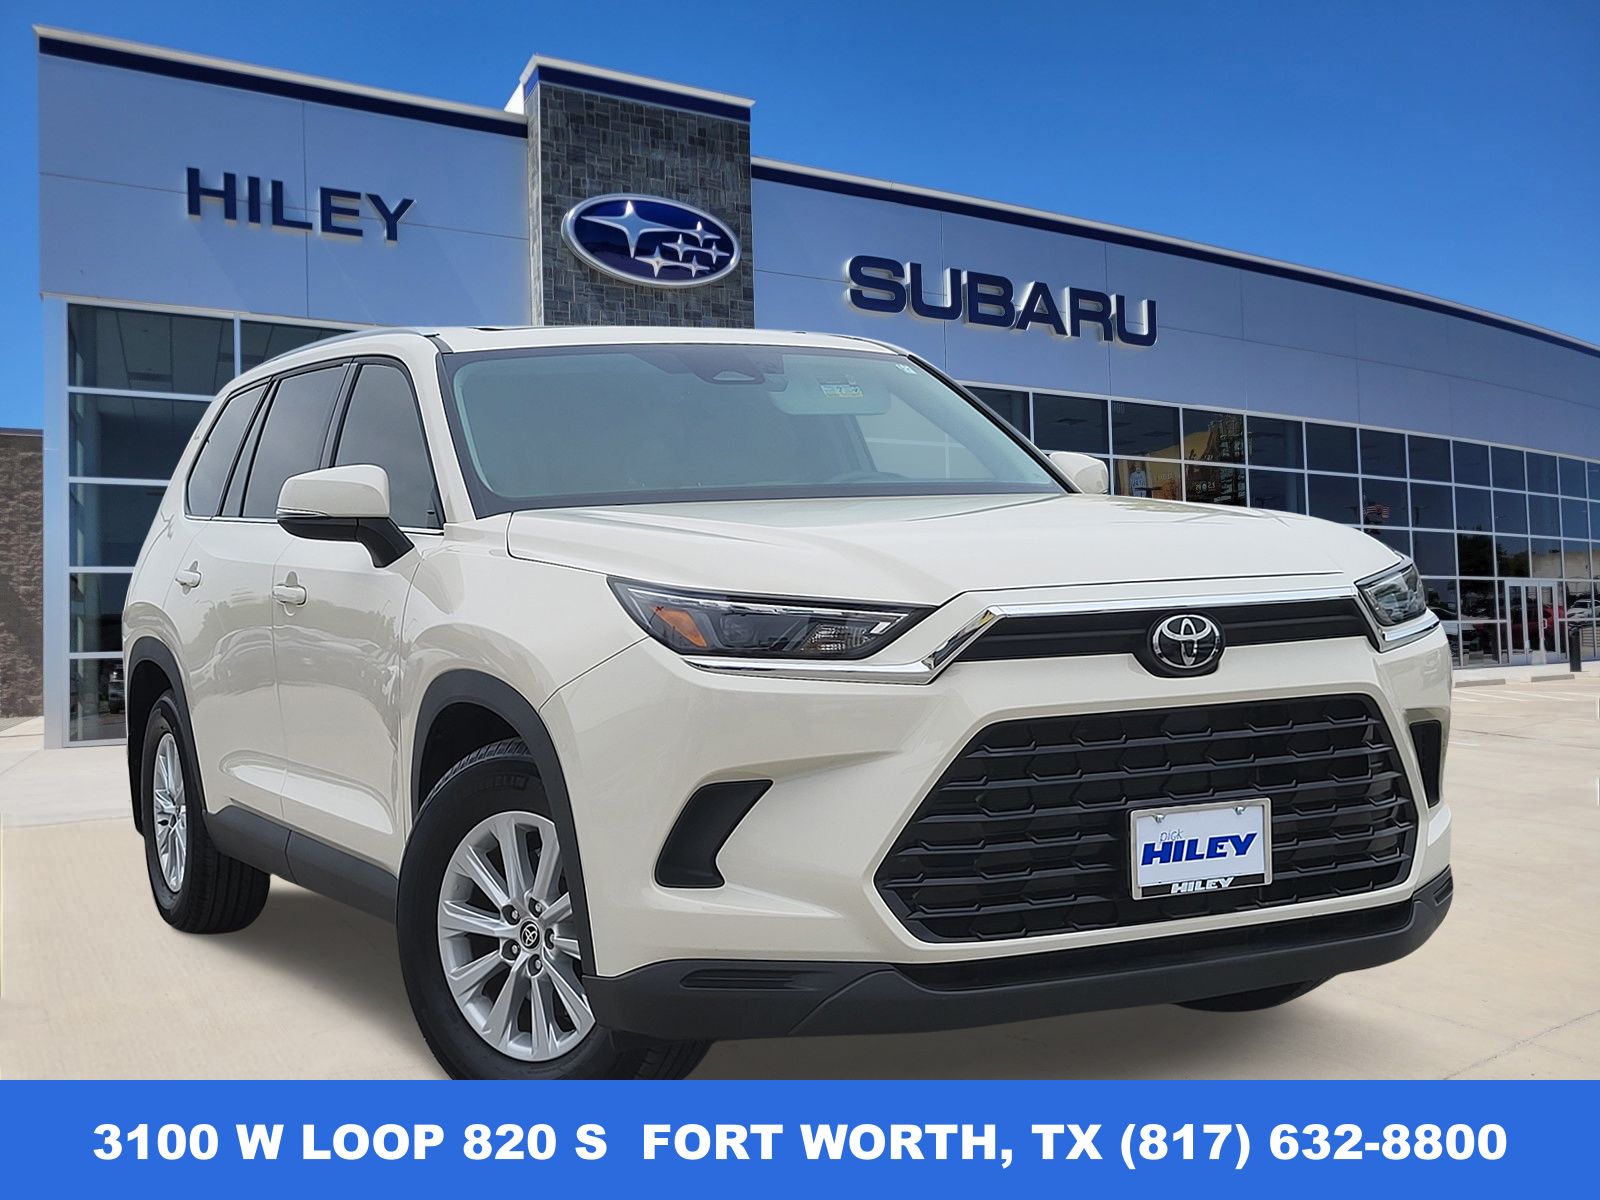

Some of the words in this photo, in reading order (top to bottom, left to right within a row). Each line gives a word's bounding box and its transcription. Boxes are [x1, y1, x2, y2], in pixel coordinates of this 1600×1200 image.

[187, 167, 415, 241] HILEY
[847, 255, 1157, 347] SUBARU
[1141, 833, 1257, 866] HILEY
[1171, 876, 1235, 894] HILEY
